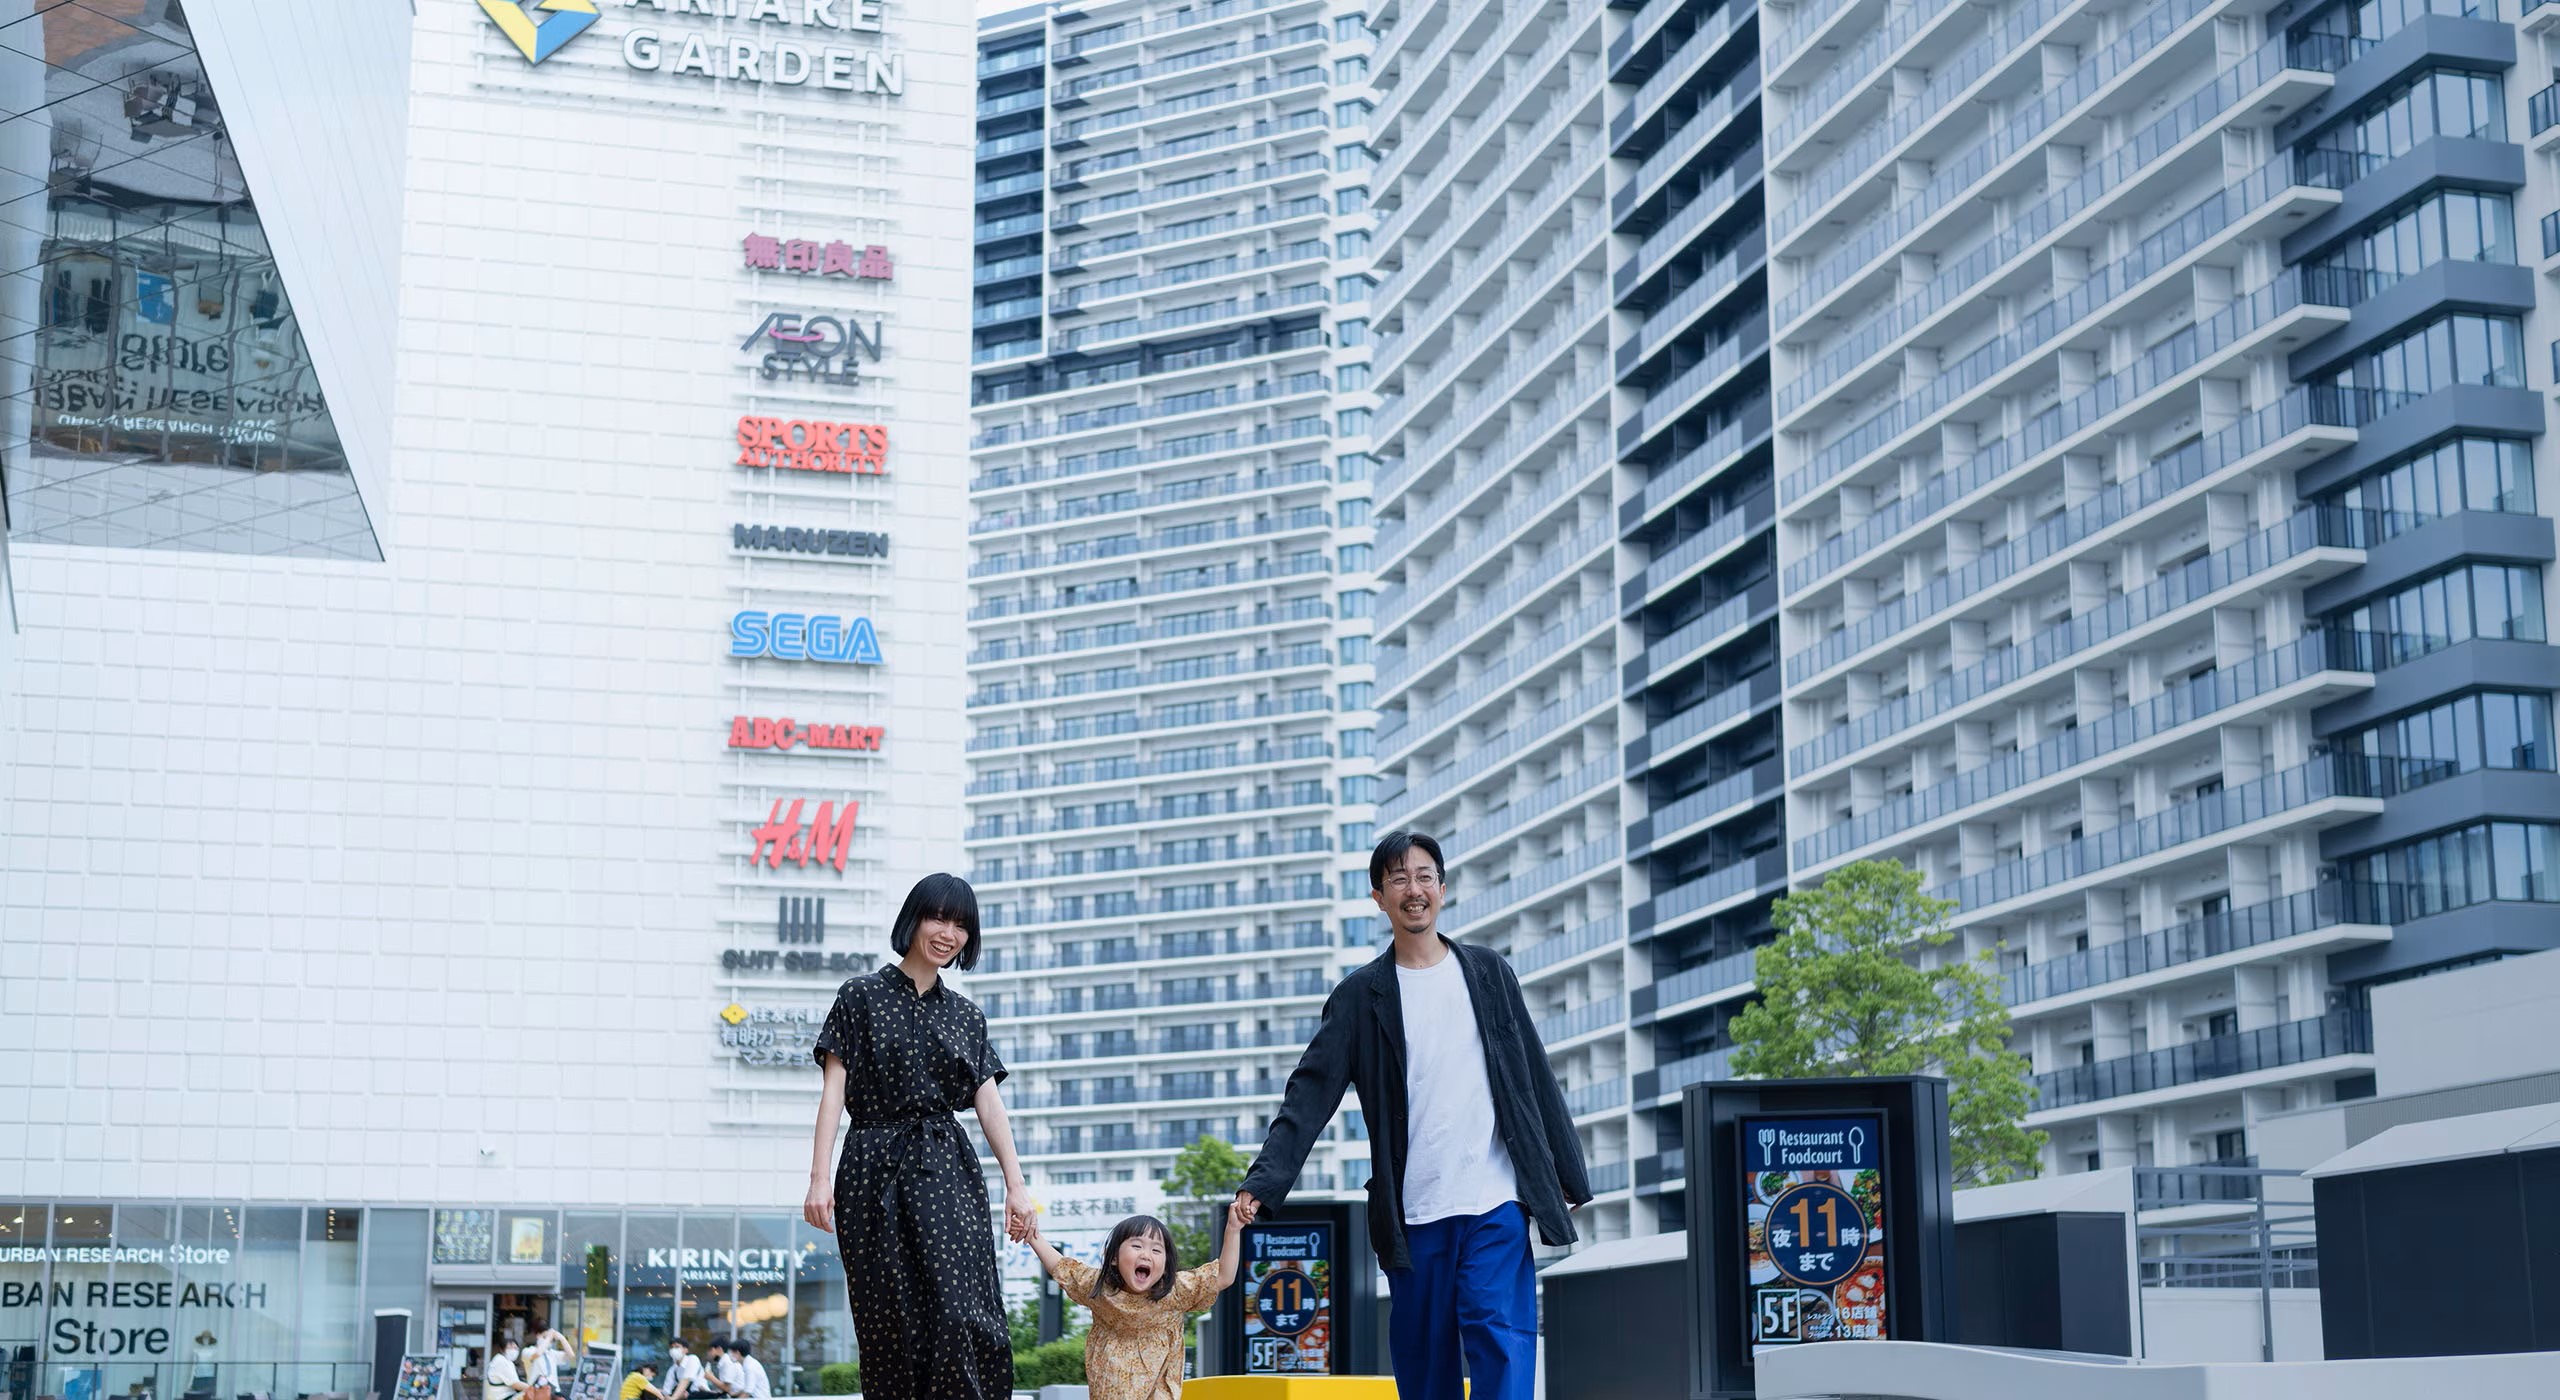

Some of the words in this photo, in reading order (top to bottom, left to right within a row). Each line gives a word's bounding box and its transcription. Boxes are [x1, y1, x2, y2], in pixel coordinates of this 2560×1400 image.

[624, 0, 881, 32] AKE
[623, 28, 904, 95] GARDEN
[743, 232, 894, 281] 無印良品
[761, 353, 860, 387] STYLE
[737, 416, 889, 456] SPORTS
[736, 446, 890, 475] AUTHORITY
[733, 523, 889, 558] MARUZEN
[730, 610, 884, 665] SEGA
[728, 716, 885, 752] ABC-MART
[751, 797, 859, 873] H&M
[722, 949, 779, 970] SUIT
[784, 951, 879, 971] SELECT
[1779, 1130, 1844, 1146] Restaurant
[1781, 1148, 1843, 1165] Foodcourt
[1049, 1197, 1136, 1216] 住友不動産
[66, 1247, 163, 1263] RESEARCH
[169, 1244, 230, 1264] Store
[1265, 1234, 1307, 1245] Restaurant
[1266, 1246, 1306, 1257] Foodcourt
[681, 1270, 728, 1280] ARIAKE
[1799, 1252, 1834, 1271] まで
[1275, 1314, 1299, 1326] まで
[1764, 1297, 1796, 1334] 5F
[53, 1318, 170, 1355] Store
[1253, 1342, 1274, 1367] 5F
